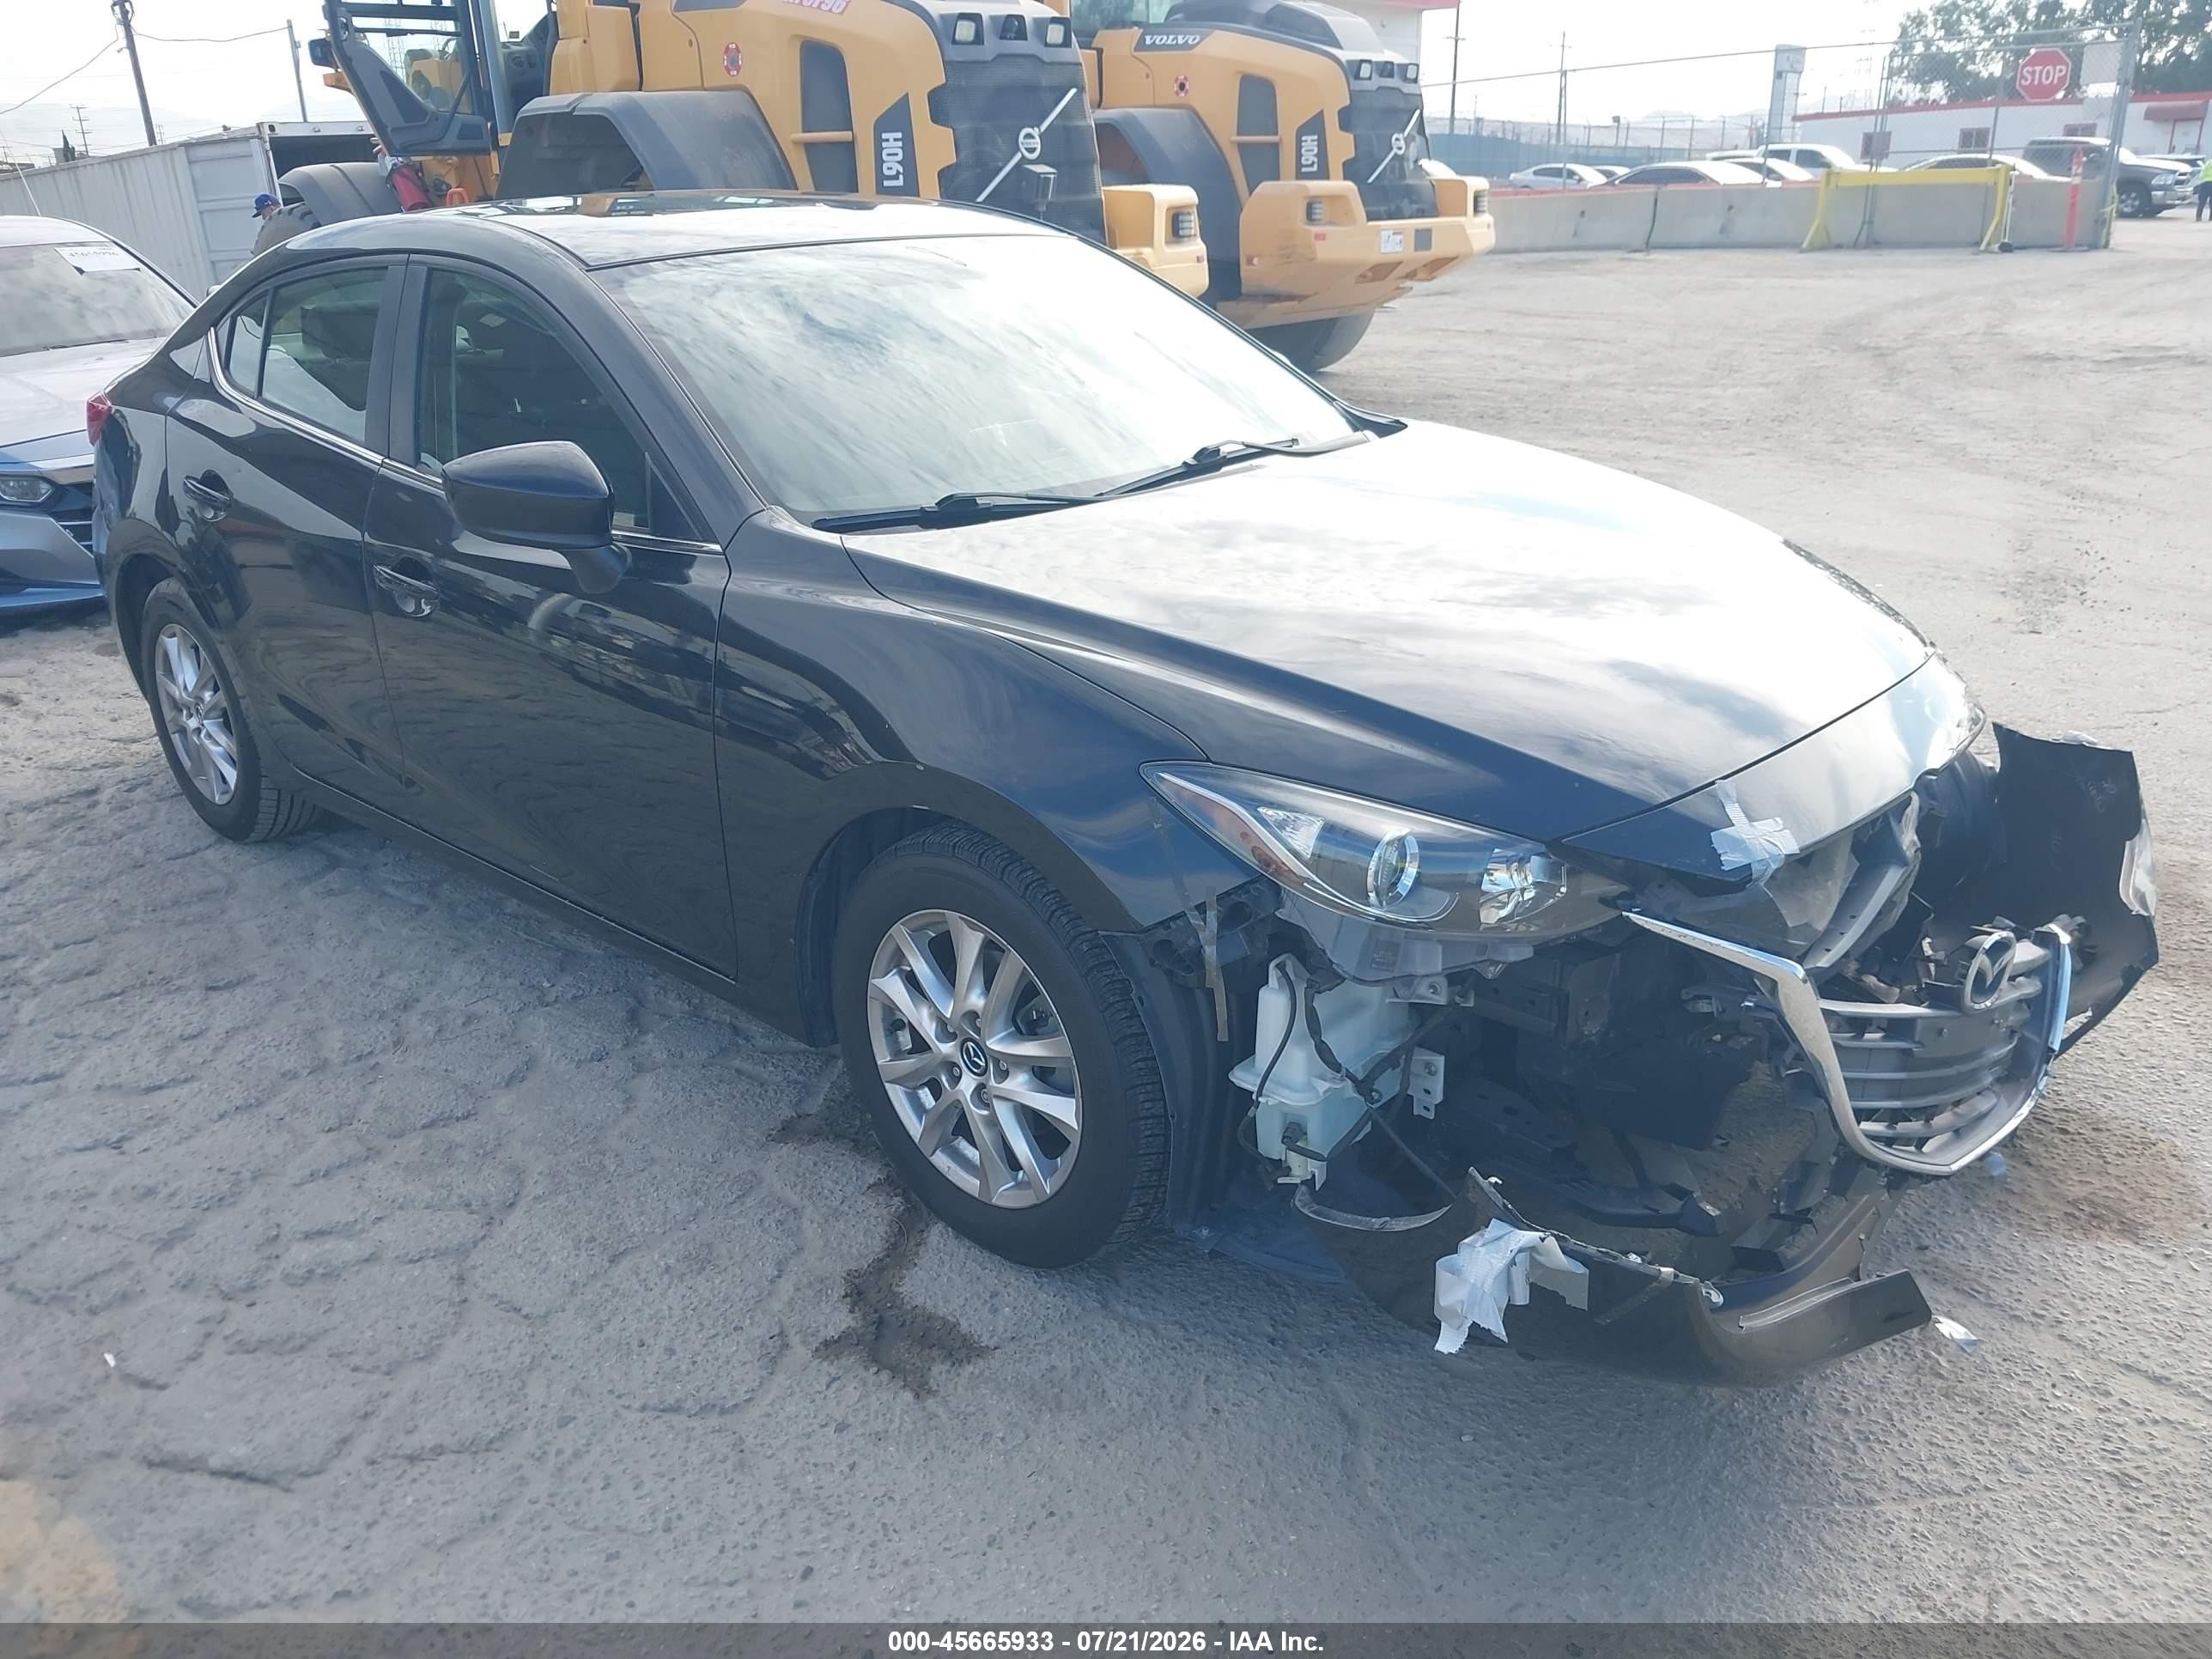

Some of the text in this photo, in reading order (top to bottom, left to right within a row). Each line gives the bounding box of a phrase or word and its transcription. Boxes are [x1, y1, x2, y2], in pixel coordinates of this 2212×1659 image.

[1145, 34, 1200, 45] VOLVO
[2021, 65, 2066, 85] STOP
[881, 131, 903, 187] L90H
[1301, 135, 1318, 173] L90H
